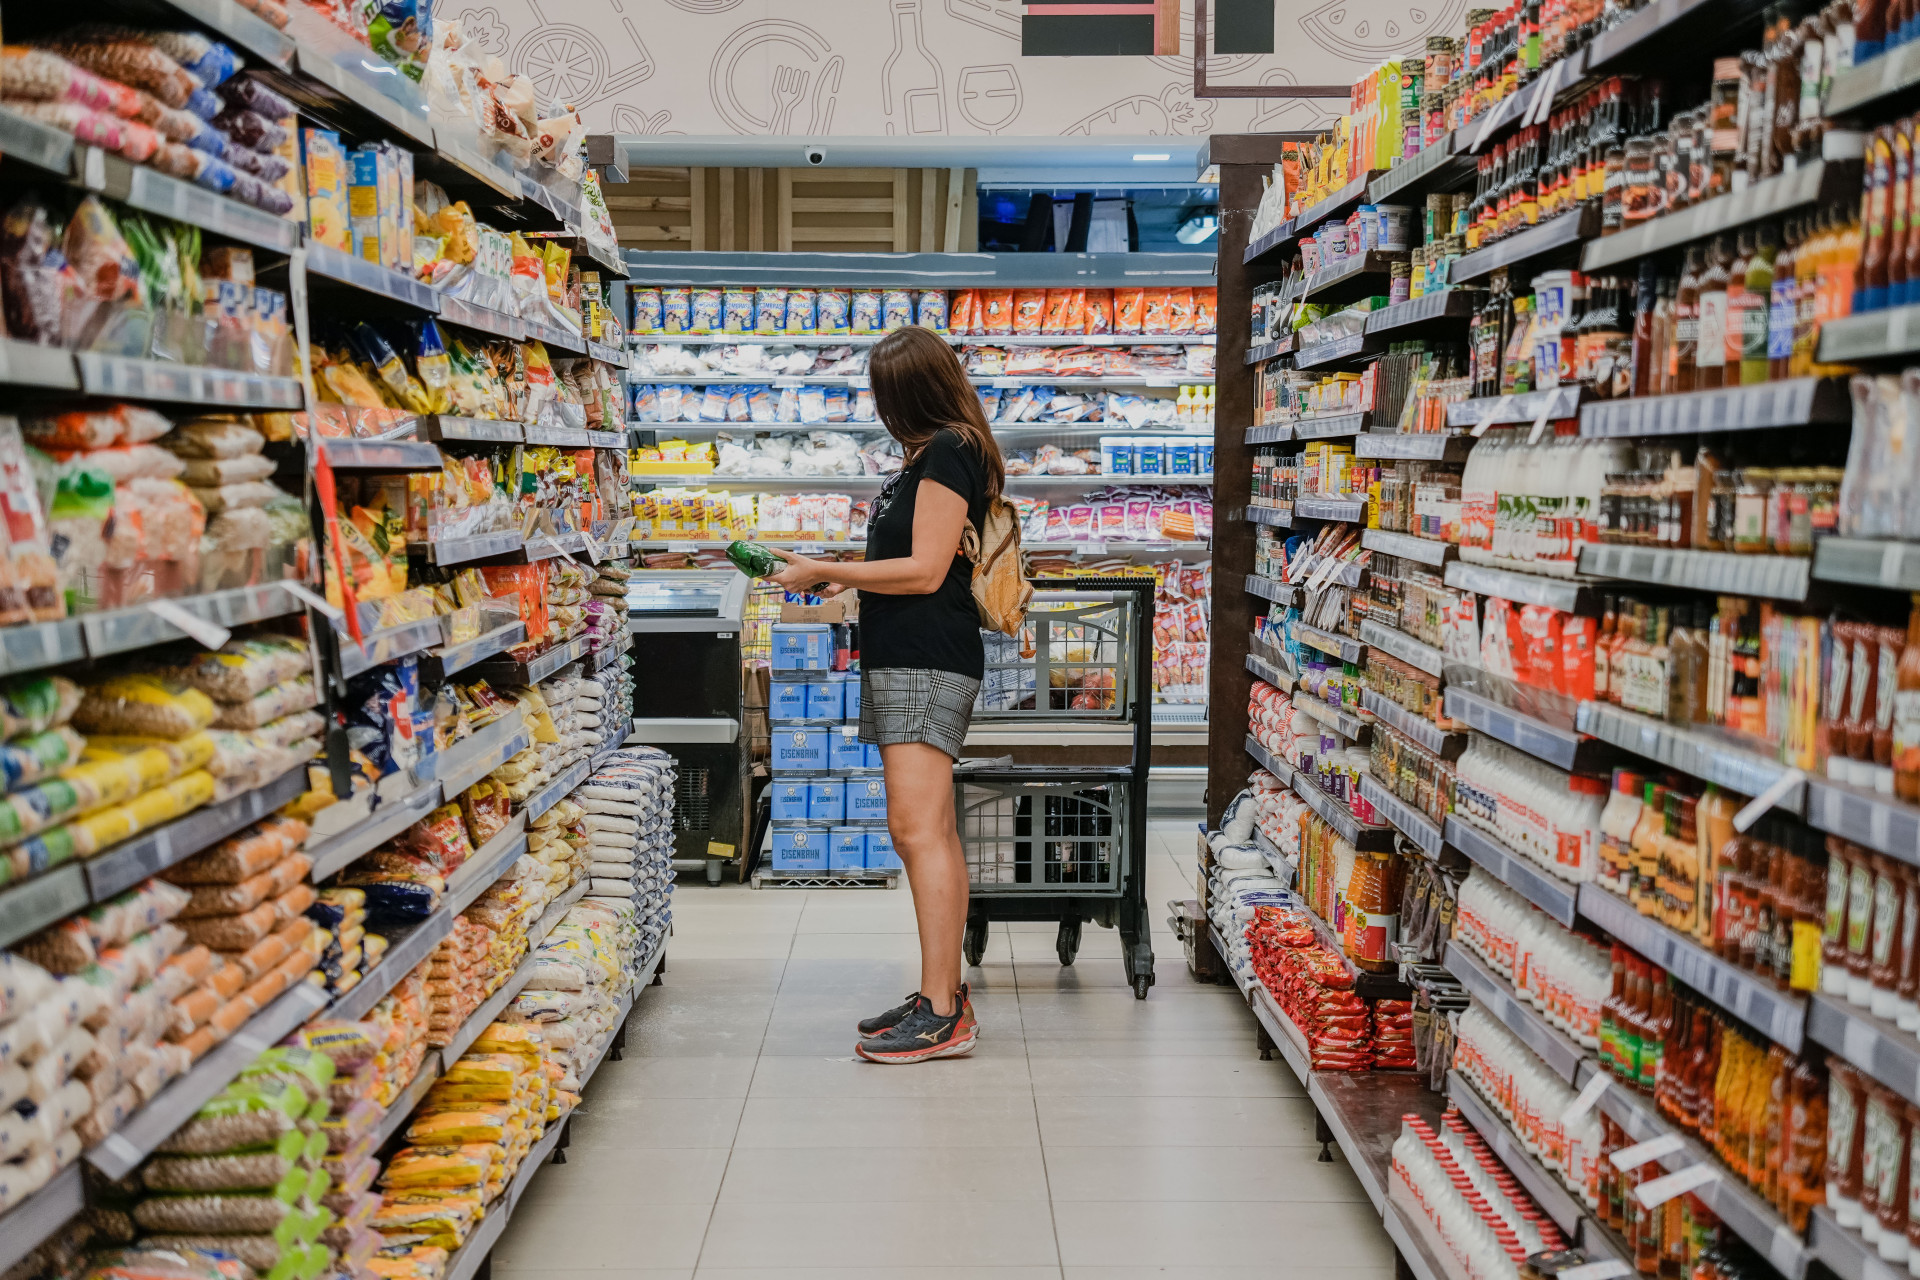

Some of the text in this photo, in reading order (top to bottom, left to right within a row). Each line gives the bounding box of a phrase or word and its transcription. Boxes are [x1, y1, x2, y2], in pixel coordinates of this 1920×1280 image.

[688, 529, 710, 540] Sadia
[794, 530, 816, 541] Sadia
[780, 748, 819, 759] EISENBAHN
[781, 849, 820, 860] EISENBAHN
